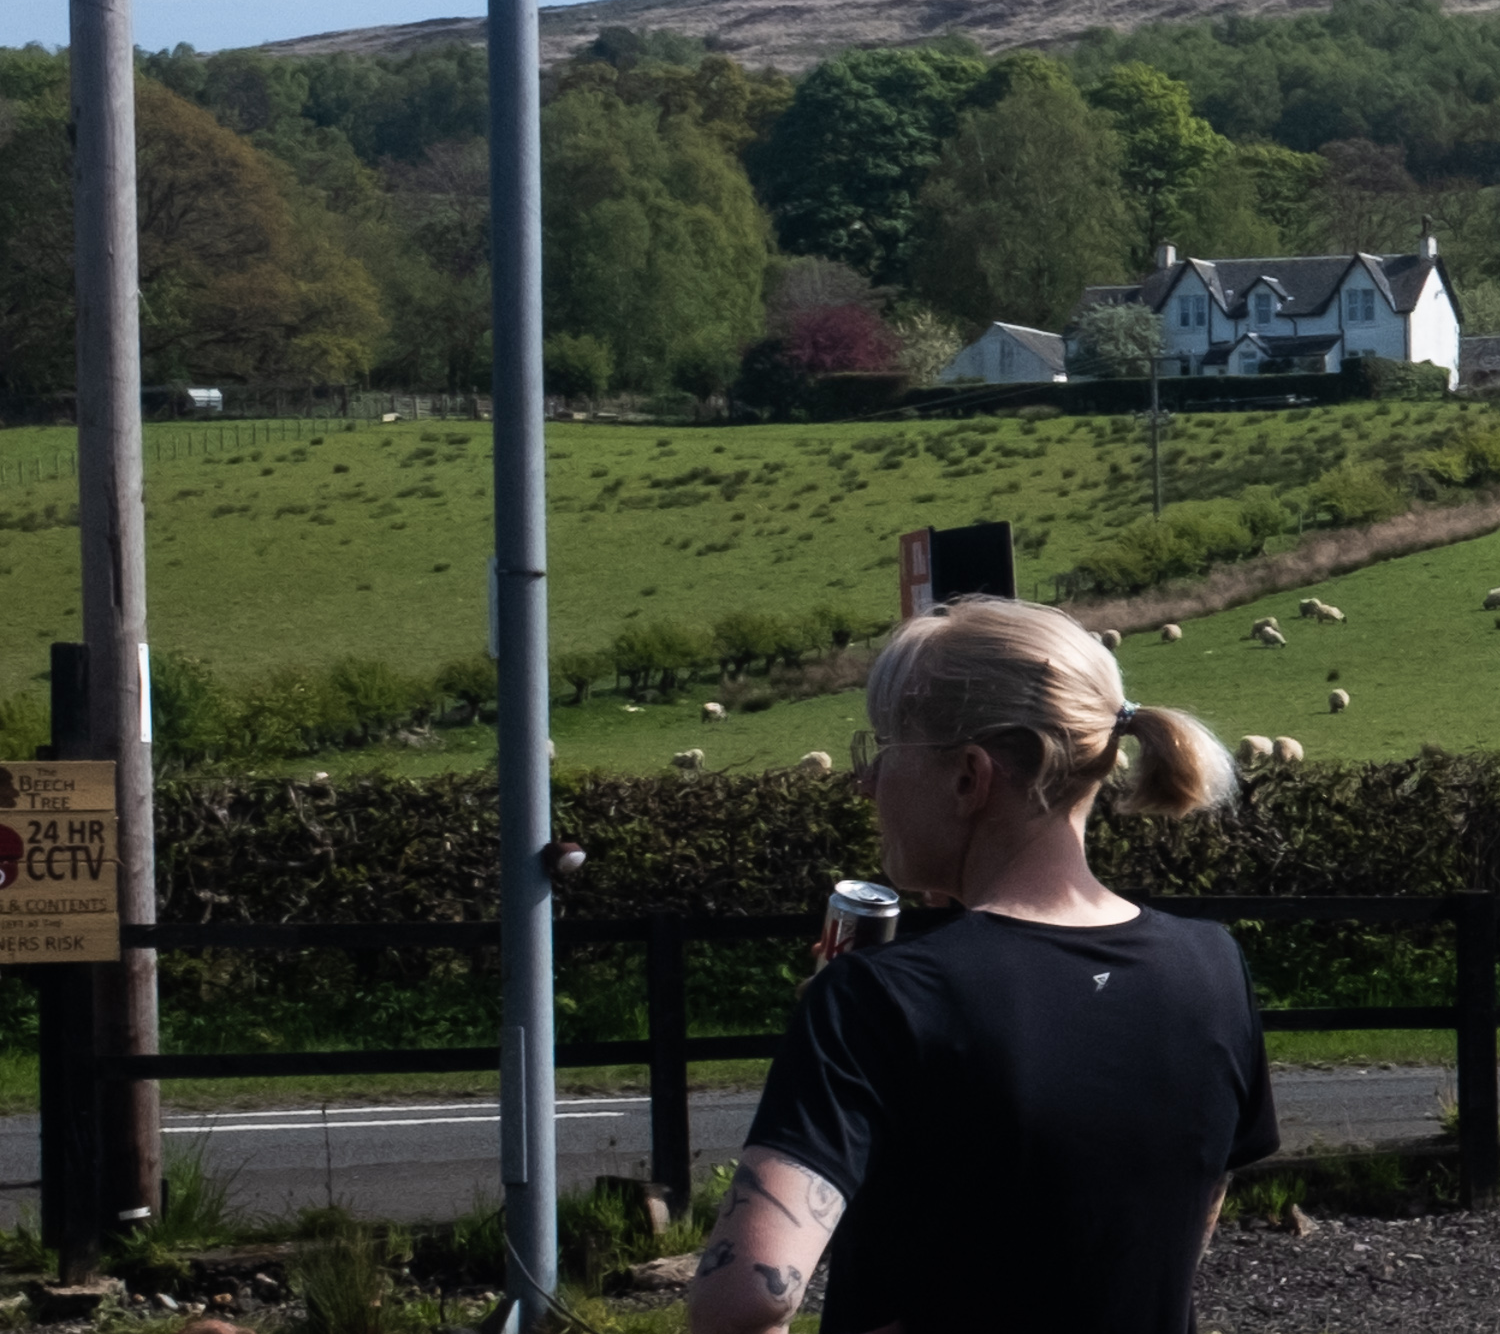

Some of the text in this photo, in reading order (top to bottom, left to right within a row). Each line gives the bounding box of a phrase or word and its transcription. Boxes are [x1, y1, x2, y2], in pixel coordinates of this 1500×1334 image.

[19, 776, 75, 792] BEECH
[26, 793, 70, 810] TREE
[27, 820, 105, 844] 24 HR
[26, 845, 105, 881] CCTV
[26, 898, 107, 913] CONTENTS
[46, 935, 84, 952] RISK
